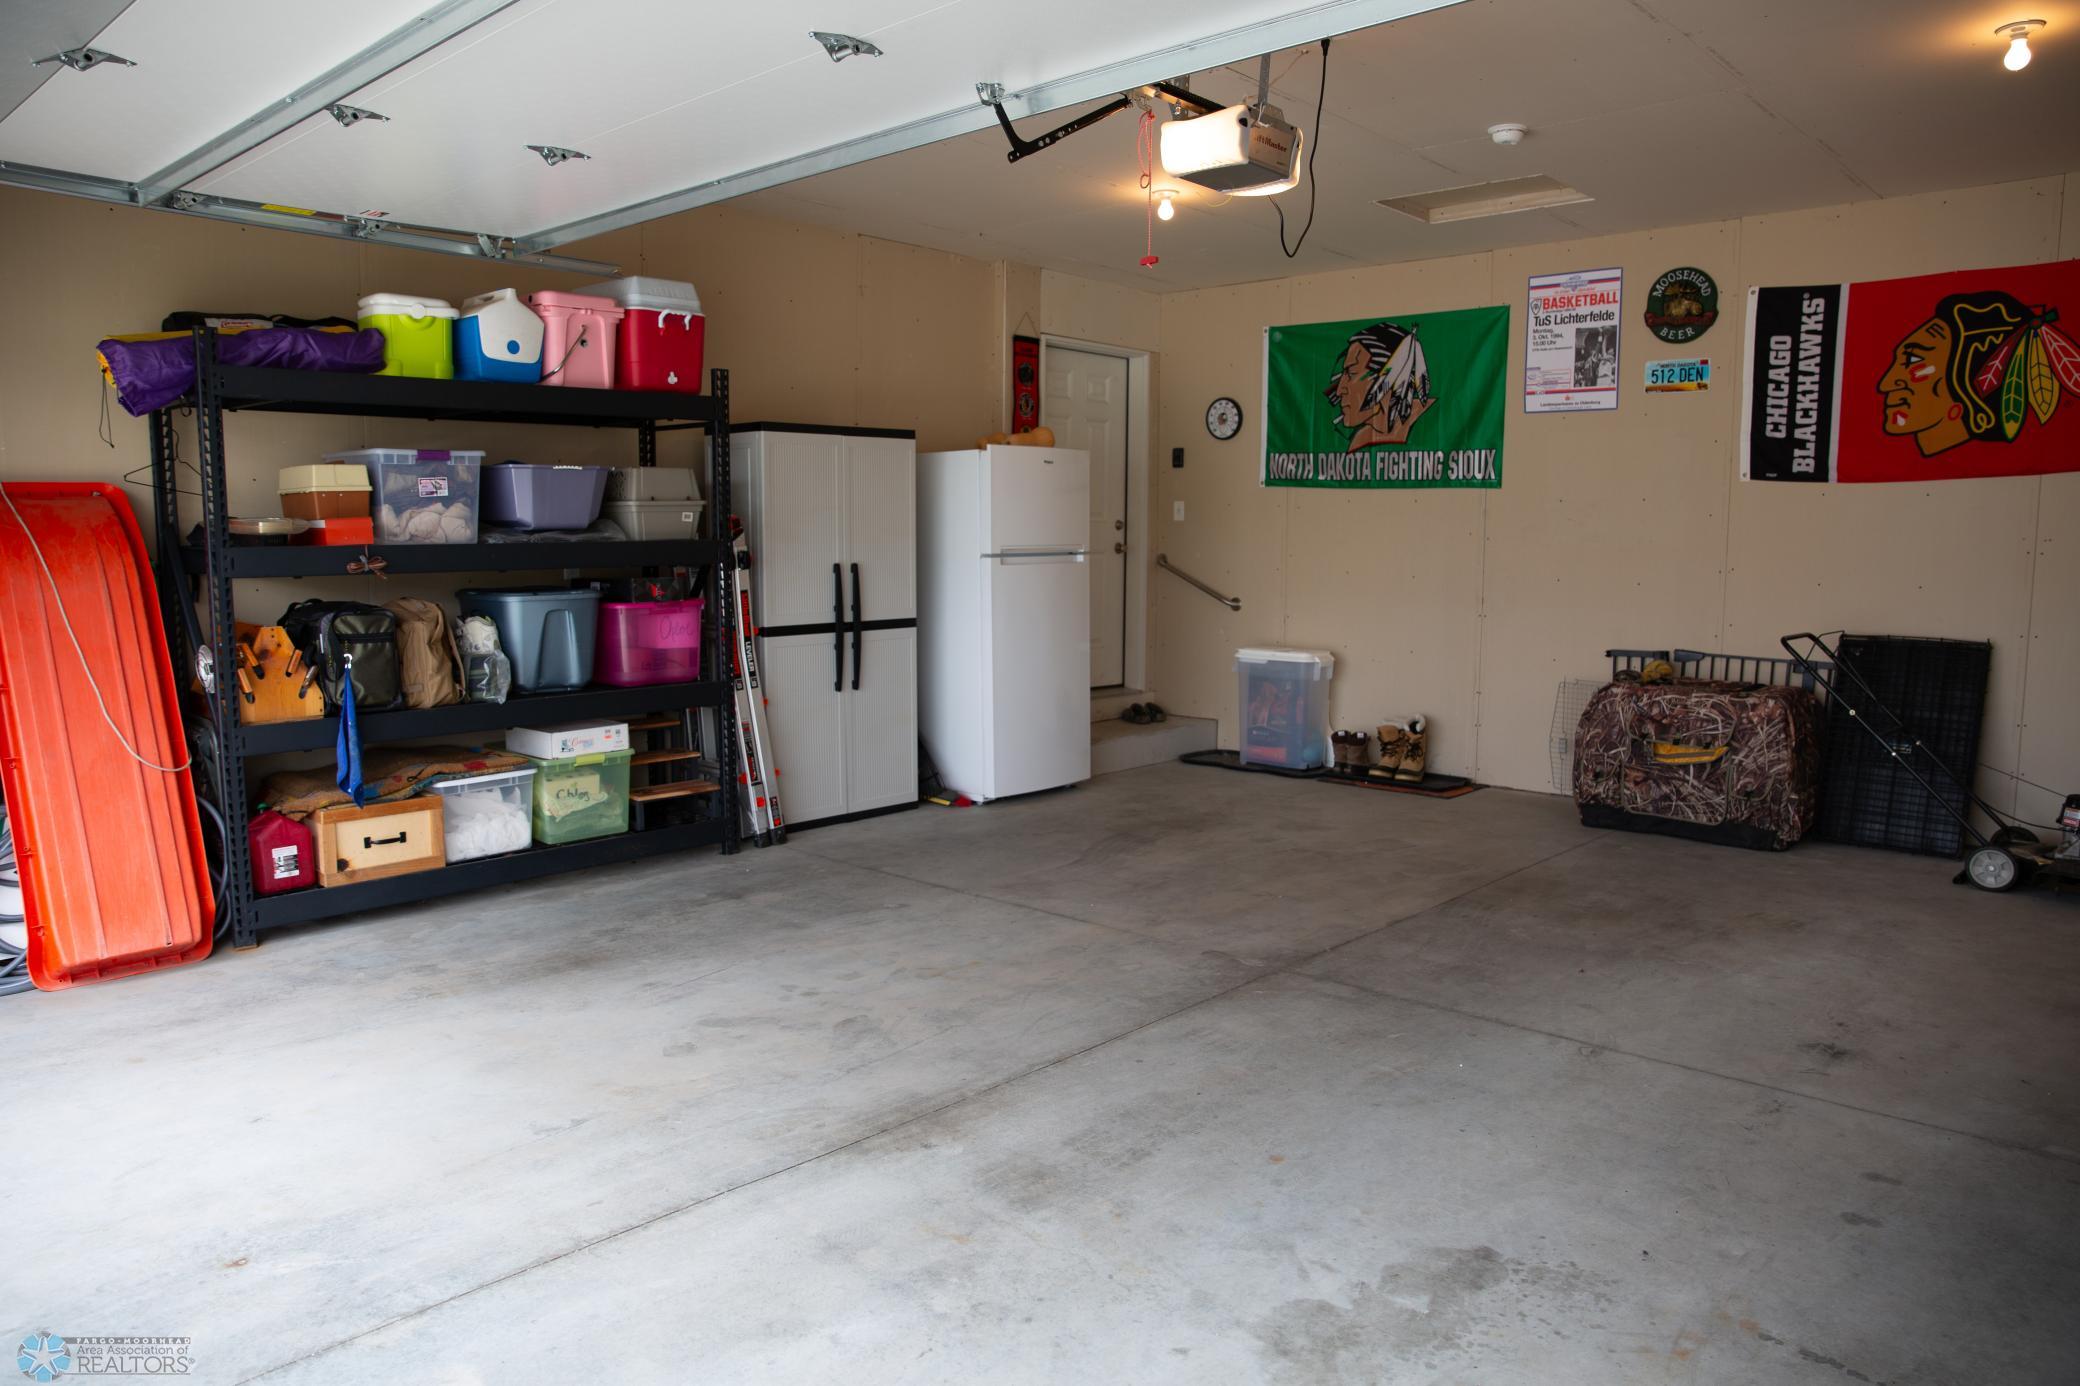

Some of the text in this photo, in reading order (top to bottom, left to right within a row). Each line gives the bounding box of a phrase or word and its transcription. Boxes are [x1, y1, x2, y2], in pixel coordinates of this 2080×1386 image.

[1652, 269, 1711, 297] MOOSEHEAD
[1542, 291, 1618, 310] BASKETBALL
[1534, 315, 1552, 327] TuS
[1554, 310, 1615, 325] Lichterfelde
[1660, 327, 1695, 340] BEER
[1651, 366, 1704, 384] 512 DEN
[1765, 335, 1792, 439] CHICAGO
[1792, 296, 1825, 474] BLACKHAWKS
[1269, 449, 1496, 481] NORTH DAKOTA FIGHTING SIOUX
[745, 641, 755, 673] LEVELER
